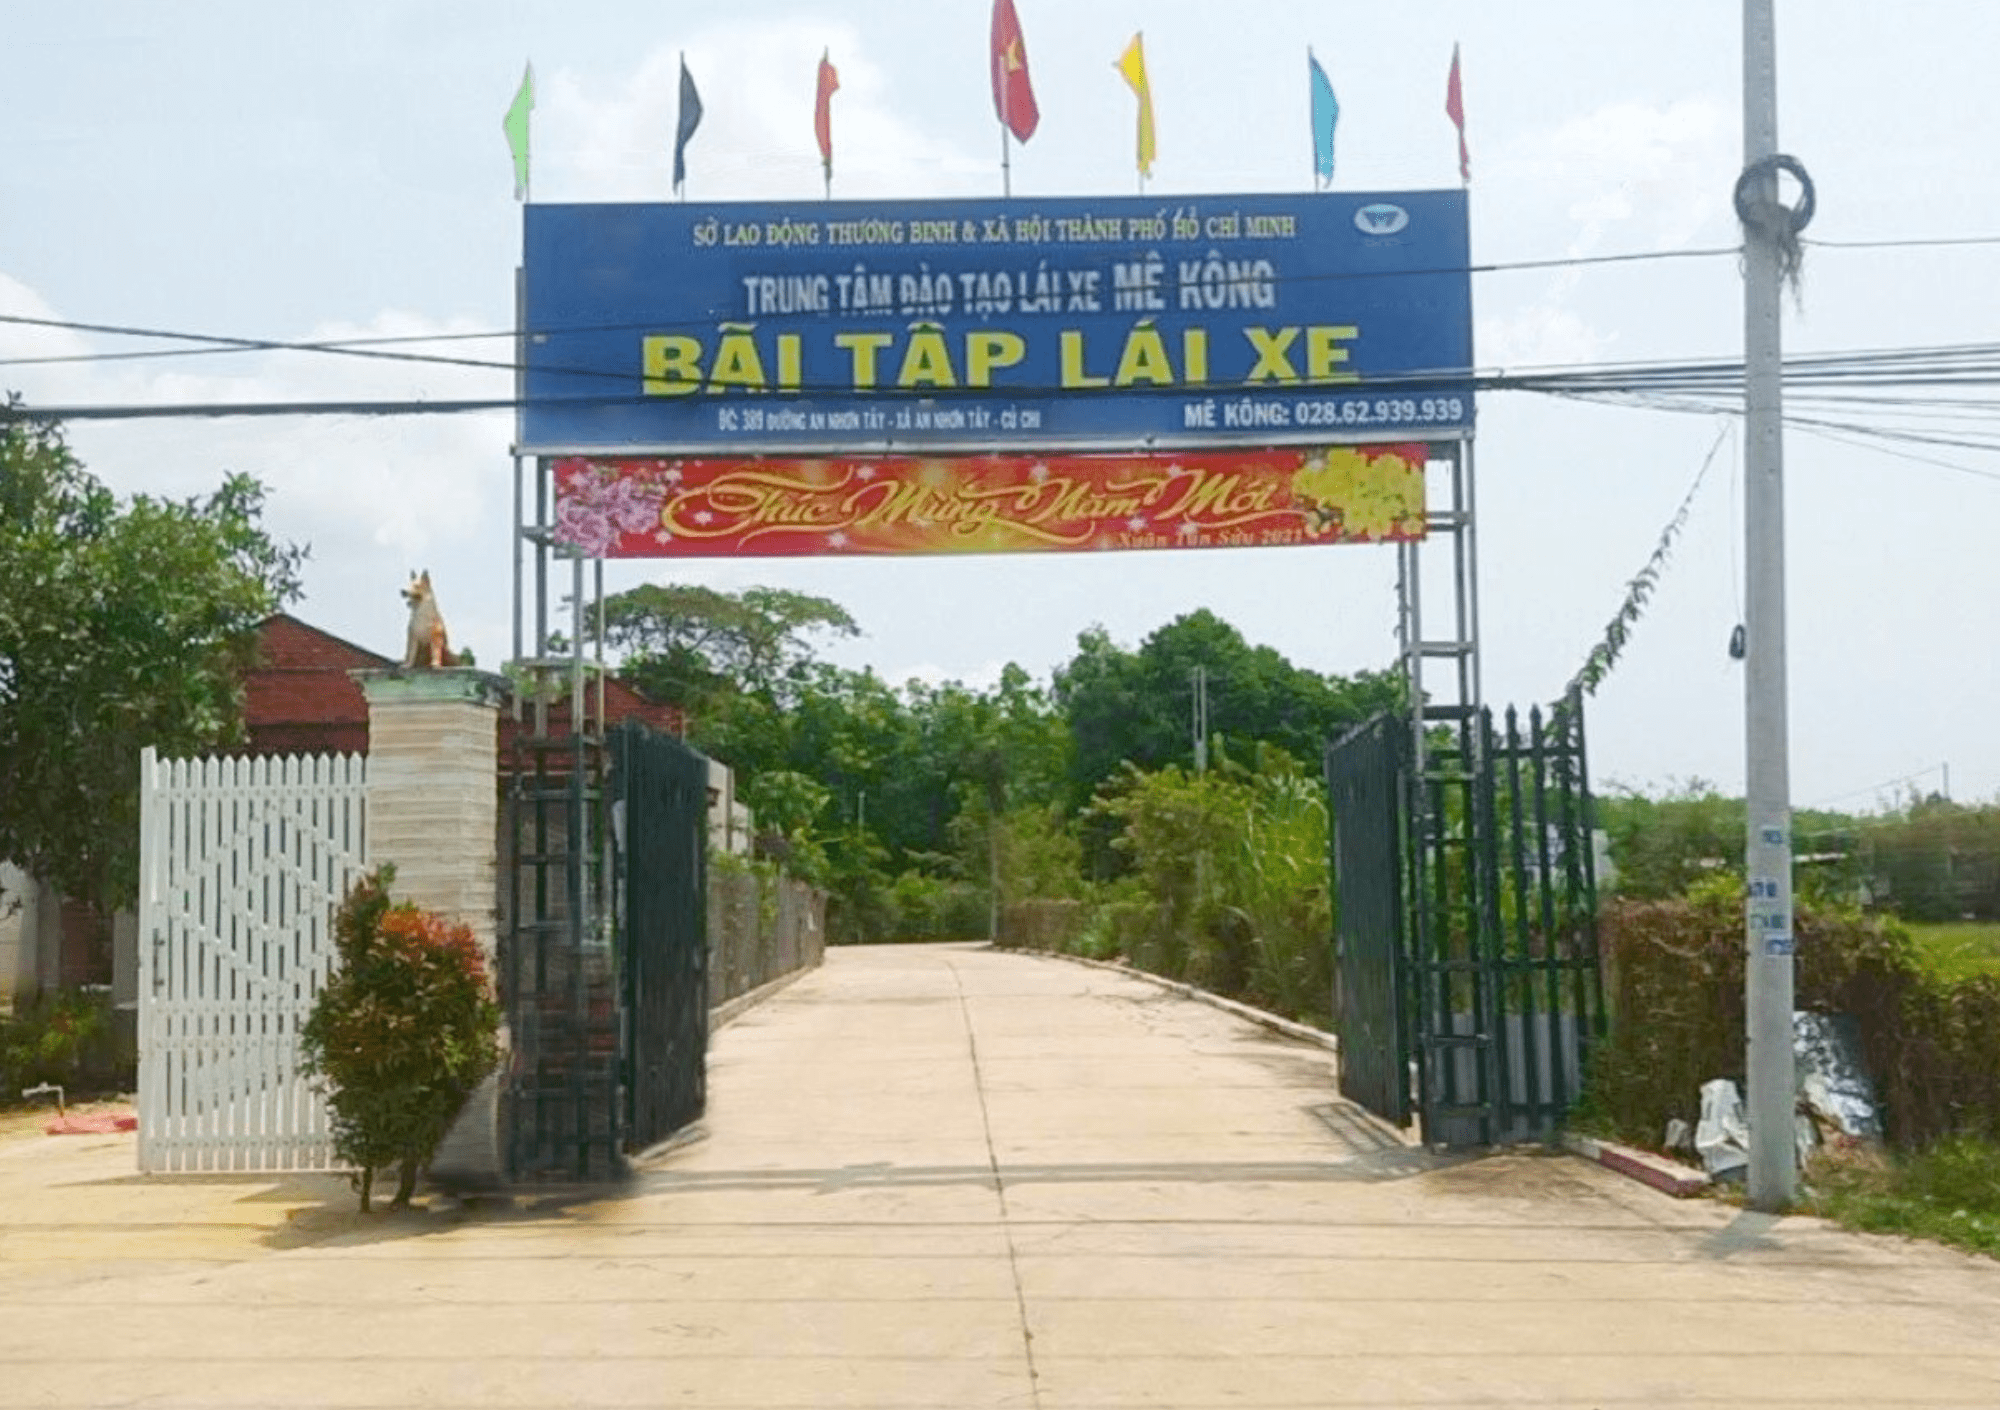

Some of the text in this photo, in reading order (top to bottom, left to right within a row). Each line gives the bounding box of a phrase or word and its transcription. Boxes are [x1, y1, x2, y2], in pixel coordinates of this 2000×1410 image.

[724, 224, 760, 245] LAO
[766, 217, 819, 248] ĐỘNG
[827, 219, 904, 245] THƯƠNG
[909, 221, 957, 243] BINH
[962, 223, 977, 243] &
[1015, 214, 1051, 245] HỘI
[1056, 213, 1122, 241] THÀNH
[1127, 208, 1166, 241] PHỐ
[1205, 211, 1240, 239] CHÍ
[1245, 216, 1296, 238] MINH
[743, 249, 1276, 323] TRUNG TÂM ĐÀO TẠO LÁI XE MÊ KÔNG
[642, 315, 1361, 405] BÃI TẬP LÁI XE
[1184, 398, 1464, 428] MÊ KÔNG: 028.62.939.939
